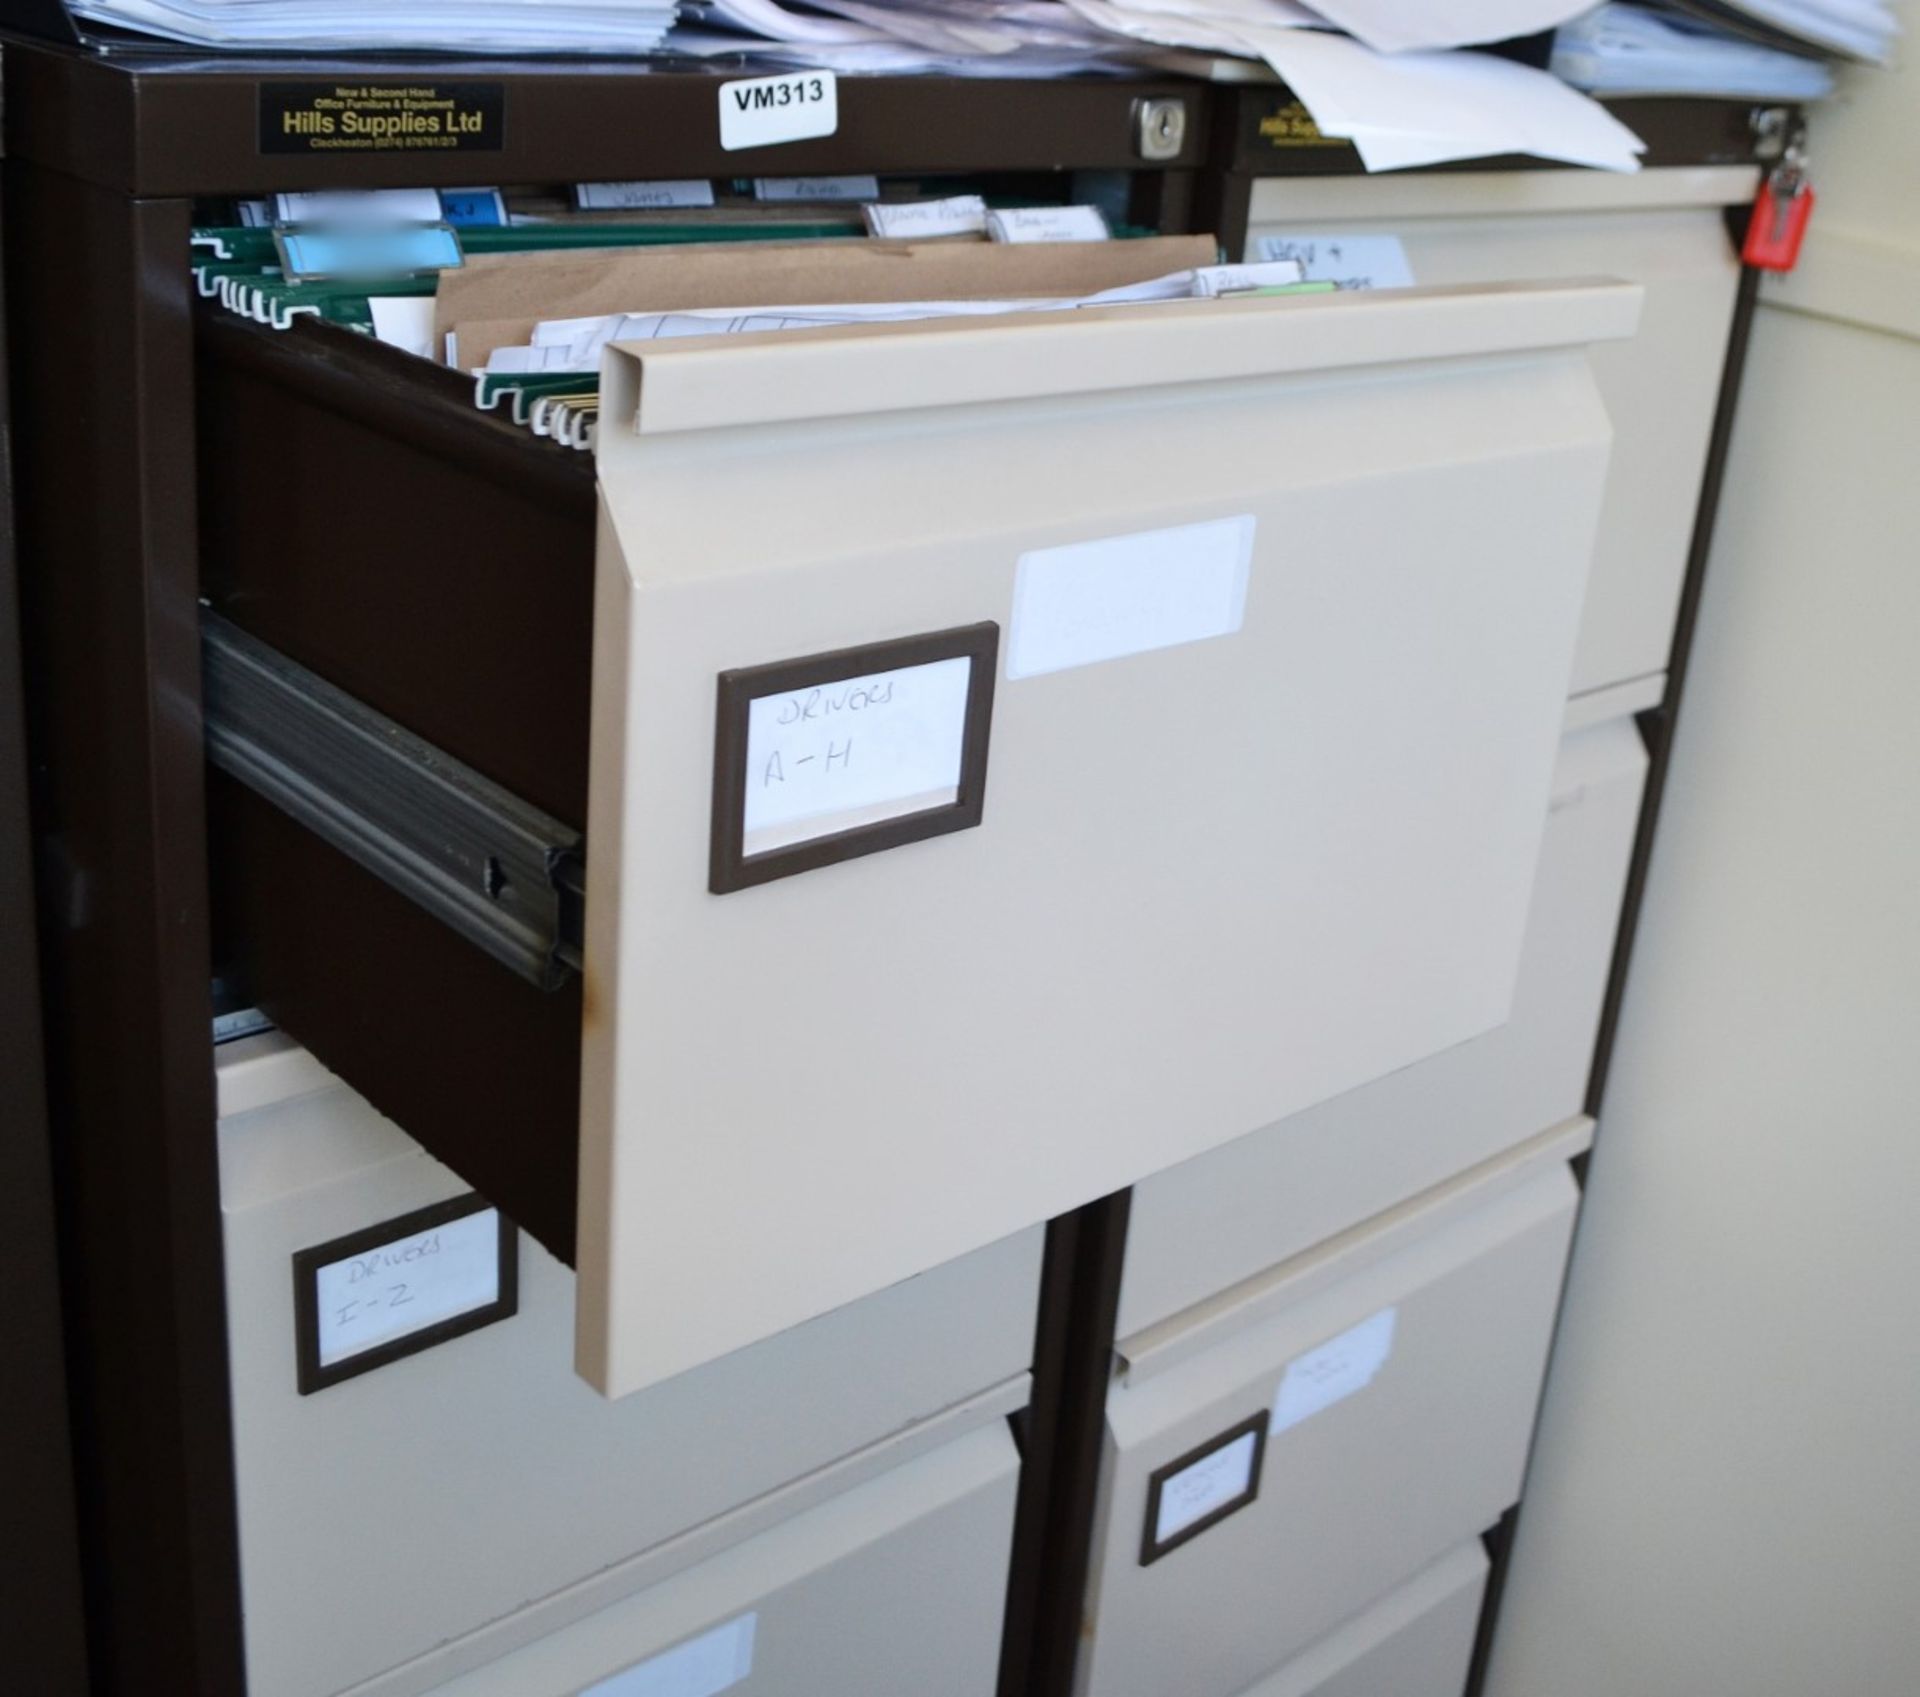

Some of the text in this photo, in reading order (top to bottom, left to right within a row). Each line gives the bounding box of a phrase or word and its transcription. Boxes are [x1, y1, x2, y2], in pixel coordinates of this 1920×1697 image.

[314, 98, 455, 111] Office Furniture & Equipment
[336, 87, 435, 98] New & Second Hand
[733, 79, 824, 111] VM313
[283, 111, 482, 137] Hills Supplies Ltd
[777, 681, 894, 725] DRIVERS
[764, 750, 785, 788] A
[826, 738, 852, 773] H
[348, 1233, 440, 1284] DRIVERS
[336, 1300, 360, 1327] I
[387, 1283, 415, 1307] Z
